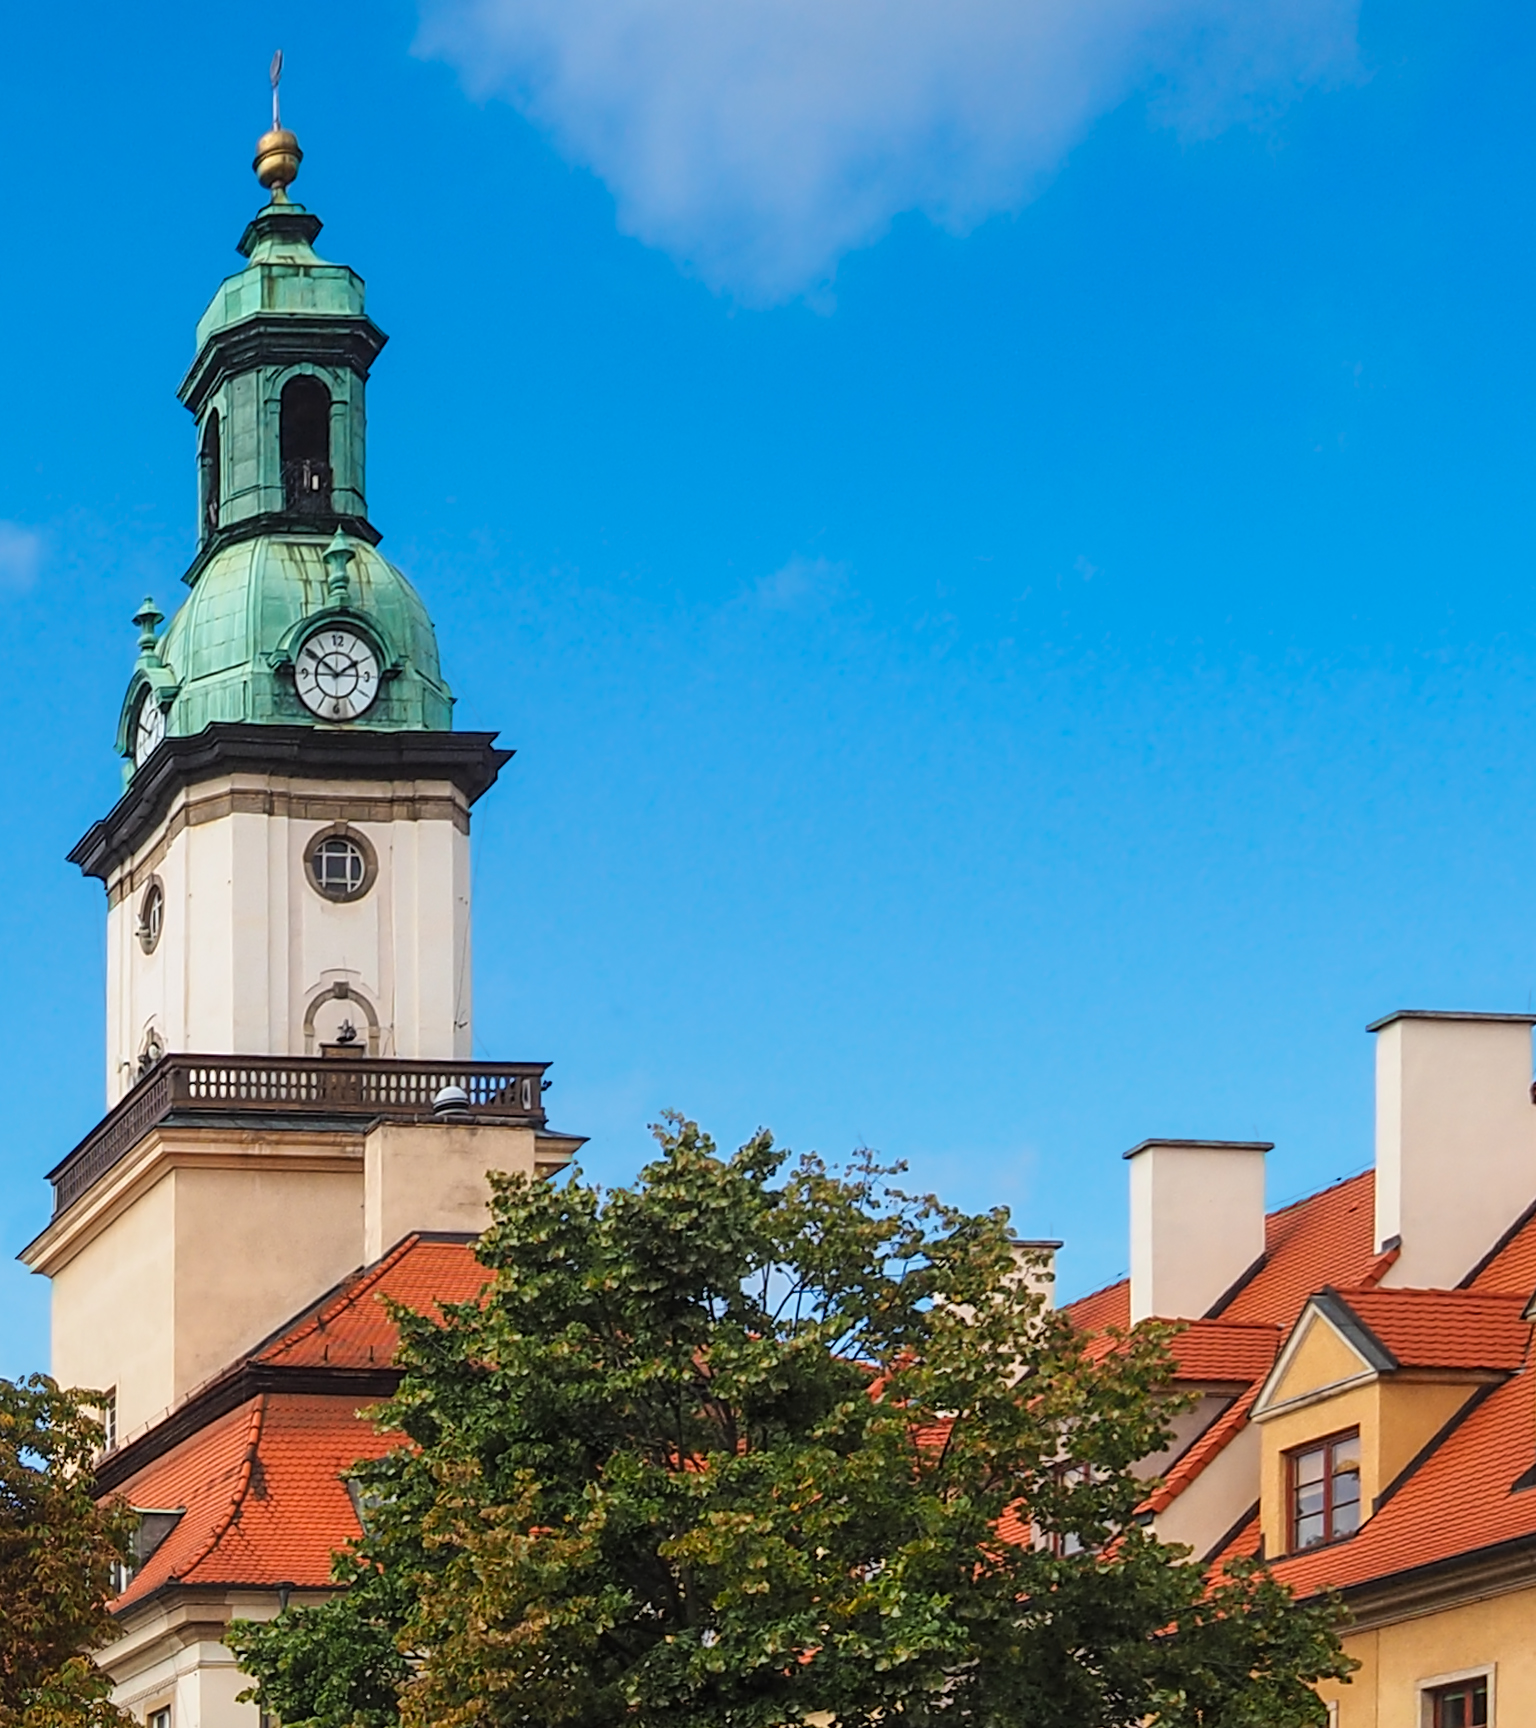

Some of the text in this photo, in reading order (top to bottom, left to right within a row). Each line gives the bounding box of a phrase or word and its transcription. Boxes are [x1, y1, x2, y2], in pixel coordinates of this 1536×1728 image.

[331, 635, 344, 647] 12
[301, 668, 309, 680] 9
[363, 671, 370, 683] 3
[332, 699, 340, 714] 6
